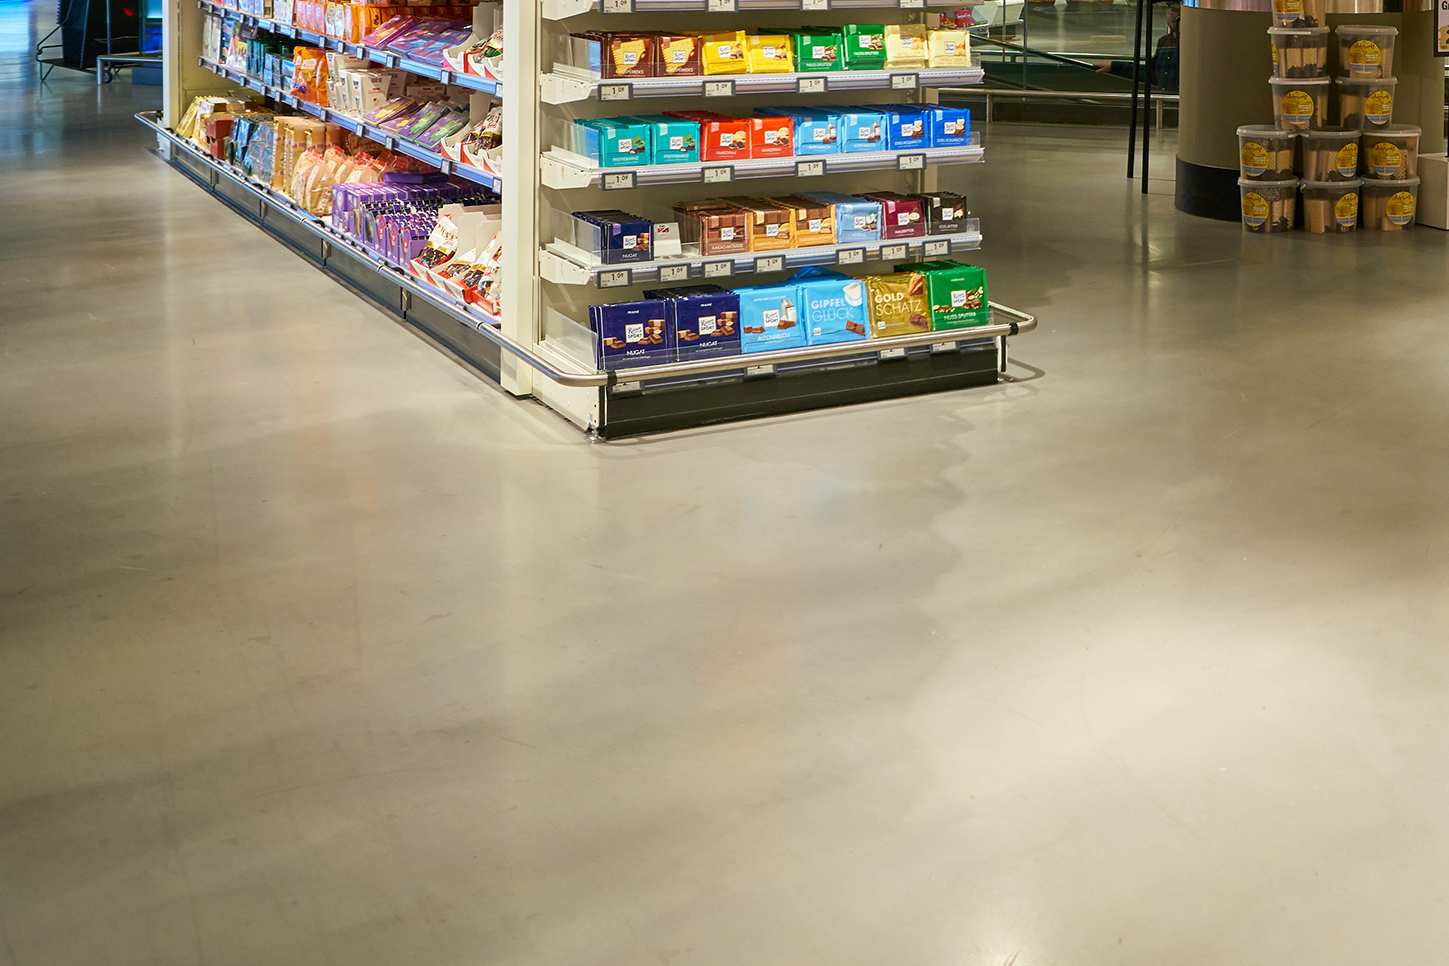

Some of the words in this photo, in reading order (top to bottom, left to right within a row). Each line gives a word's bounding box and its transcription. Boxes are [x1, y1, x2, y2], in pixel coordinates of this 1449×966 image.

[811, 297, 846, 309] GIPFEL
[875, 292, 904, 304] GOLD
[811, 306, 854, 322] GLÜCK
[875, 300, 923, 317] SCHATZ
[627, 332, 643, 340] SPORT
[626, 348, 645, 356] NUGAT
